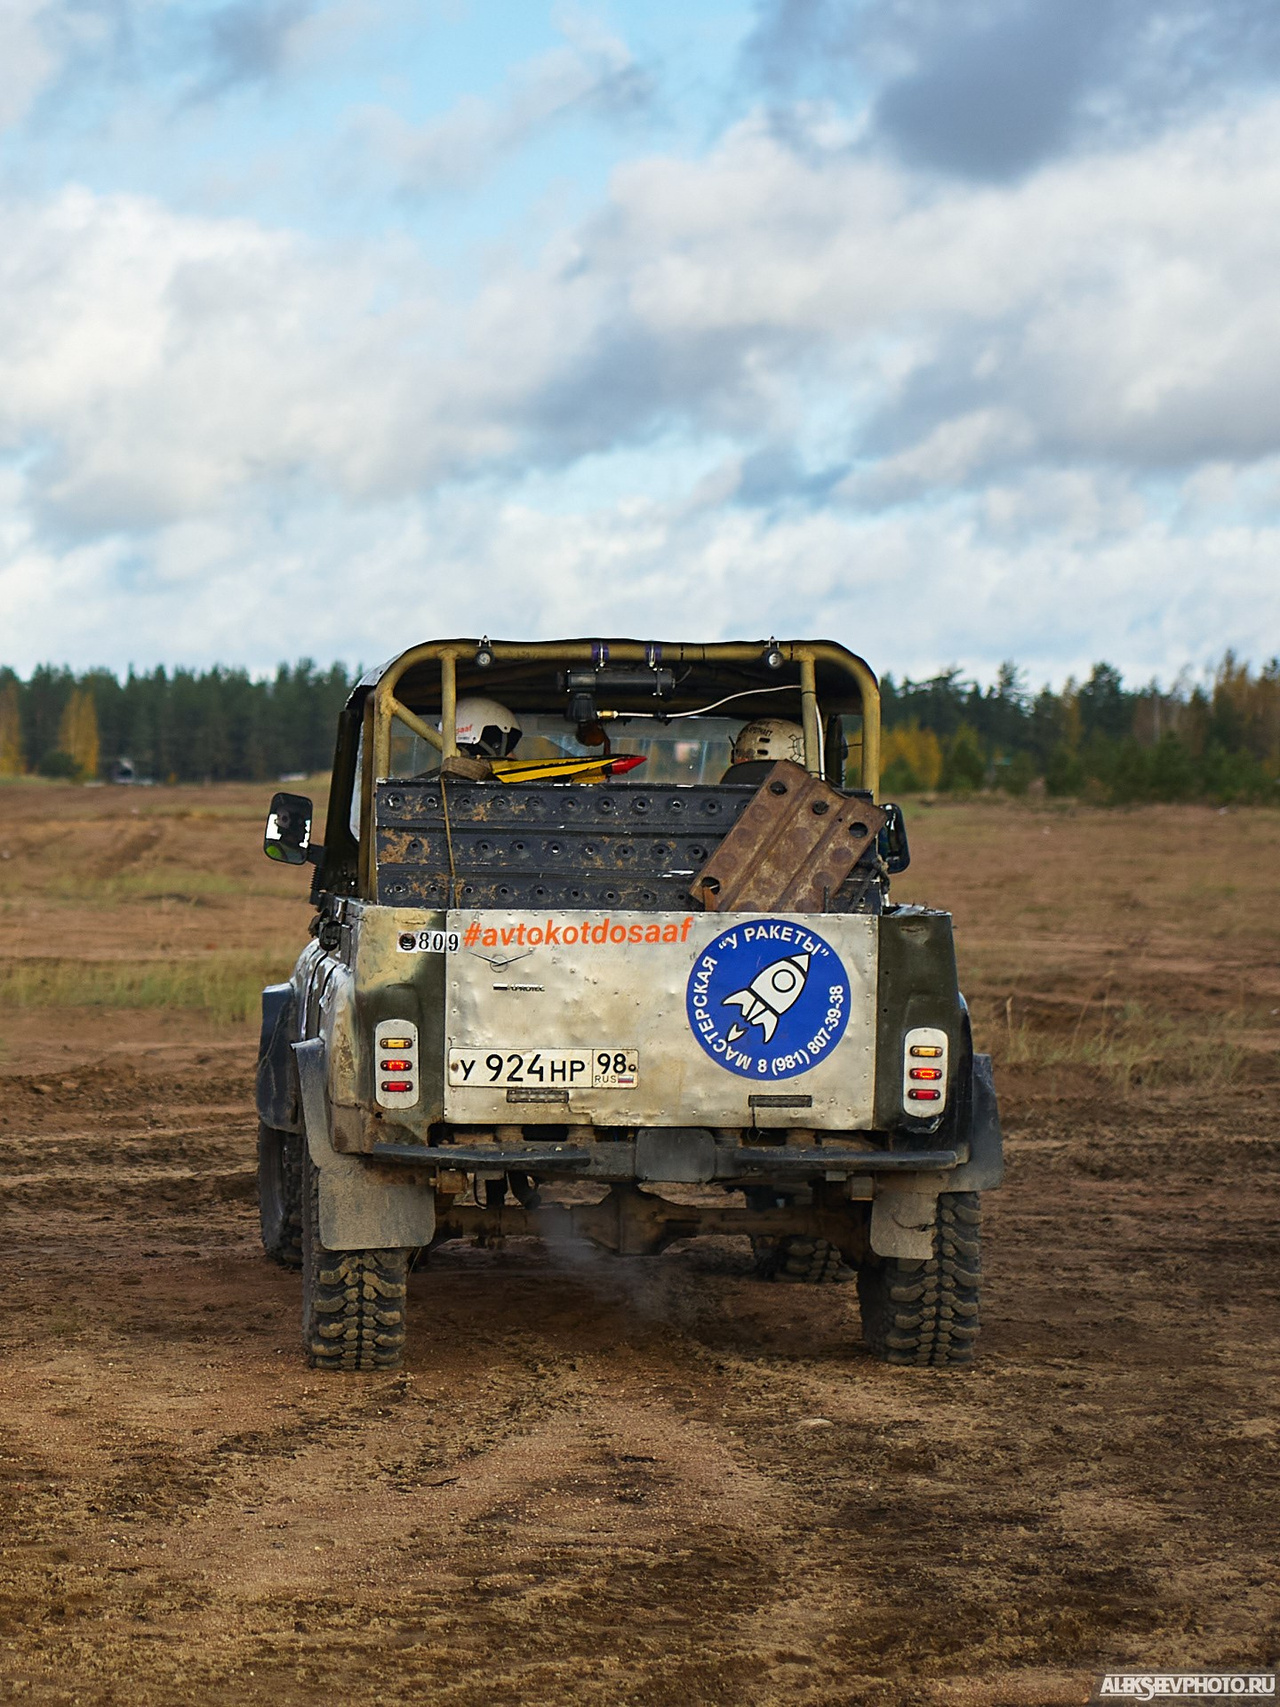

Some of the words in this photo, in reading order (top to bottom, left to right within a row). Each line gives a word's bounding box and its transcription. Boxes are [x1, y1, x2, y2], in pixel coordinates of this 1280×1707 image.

[418, 932, 459, 952] 809
[463, 916, 695, 948] #avtokotdosaaf
[693, 955, 752, 1071] МАСТЕРСКАЯ
[757, 1059, 768, 1073] 8
[771, 1049, 810, 1076] (981)
[807, 985, 844, 1055] 807-39-38
[597, 1053, 627, 1075] 98
[594, 1075, 617, 1084] RUS
